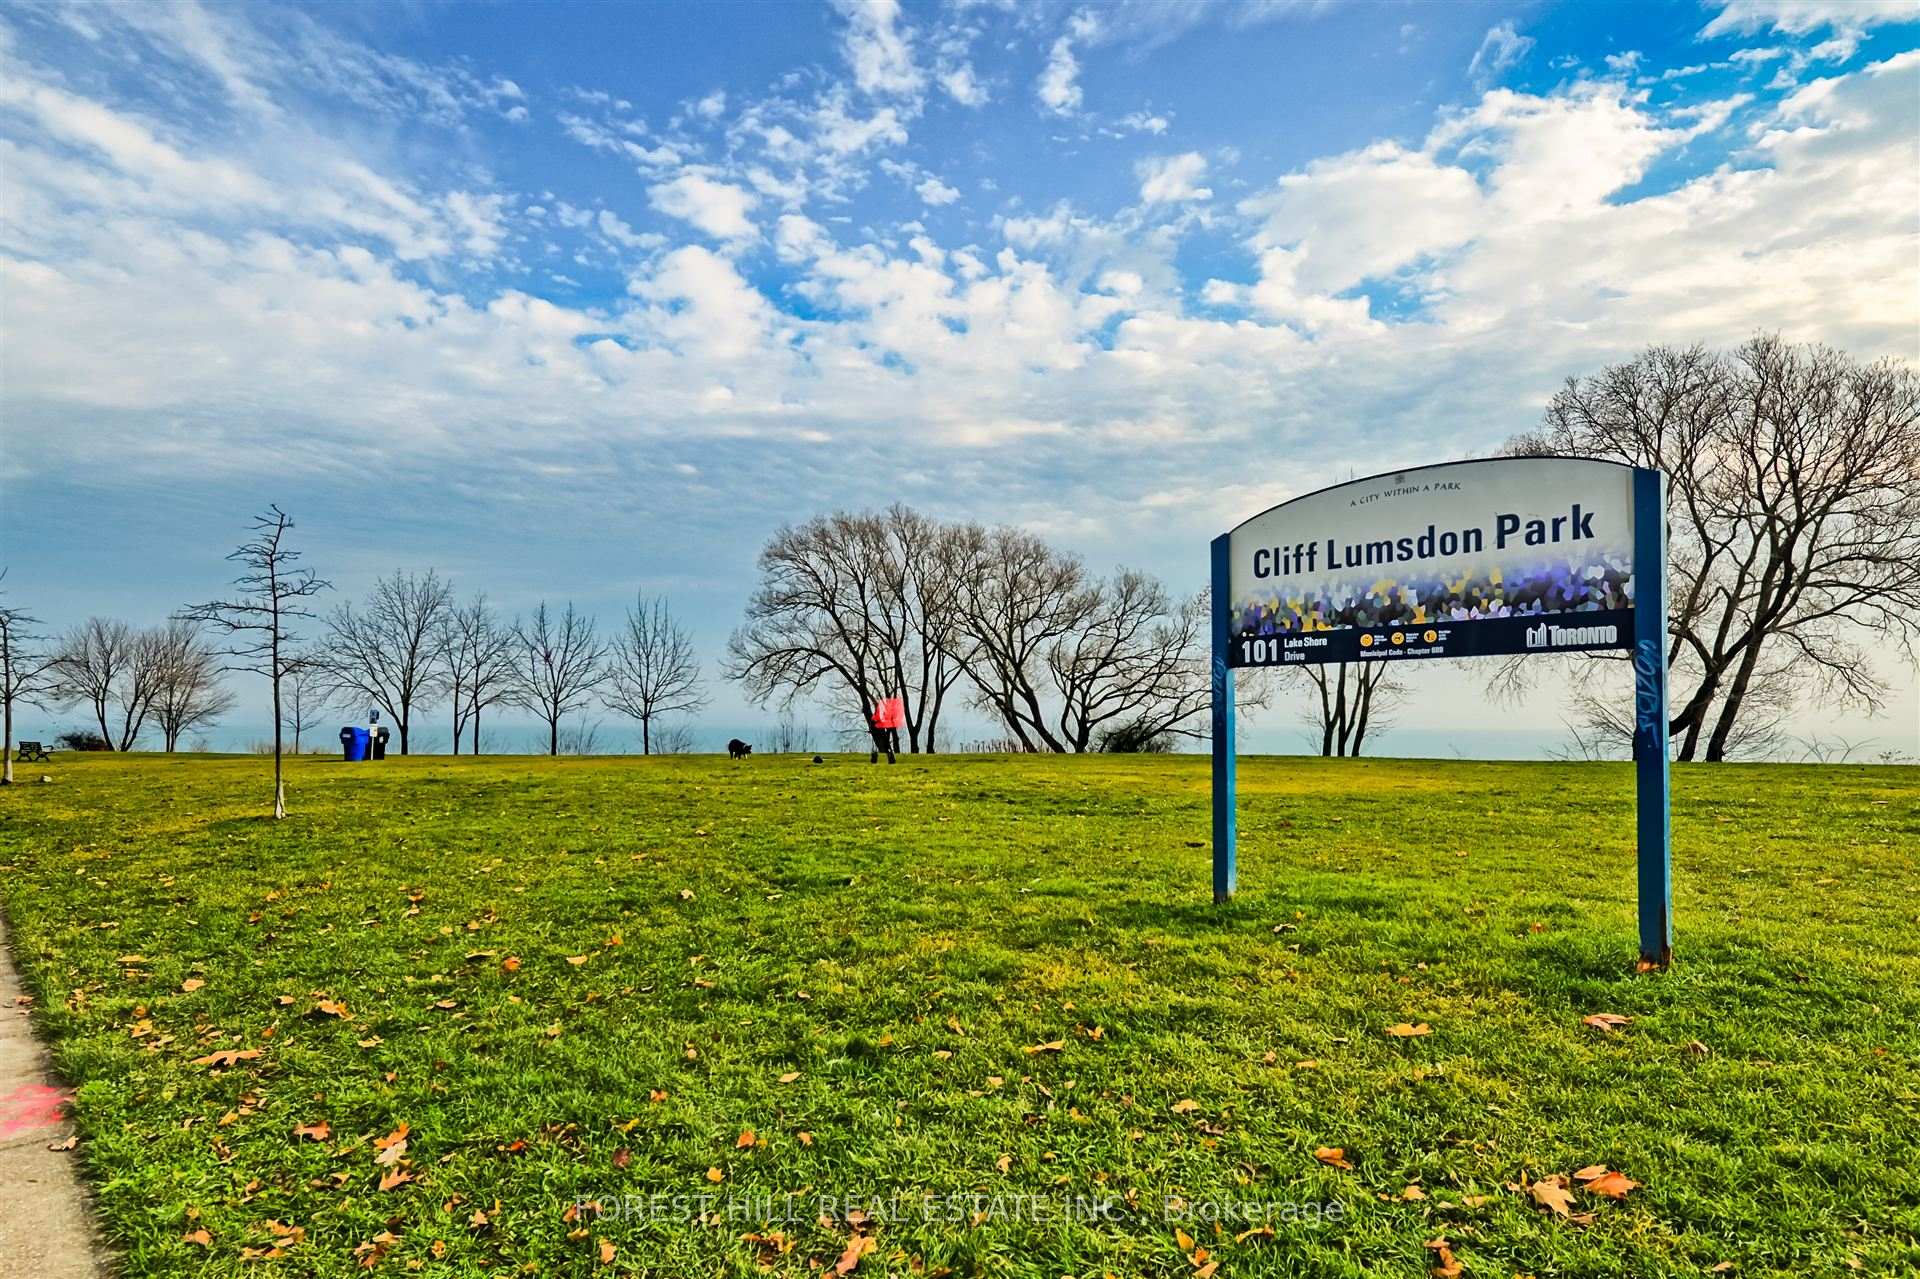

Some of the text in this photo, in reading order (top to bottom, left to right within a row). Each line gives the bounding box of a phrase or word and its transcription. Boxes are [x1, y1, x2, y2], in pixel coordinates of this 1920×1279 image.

[1359, 493, 1380, 505] CITY
[1383, 485, 1420, 497] WITHIN
[1434, 482, 1462, 491] PARK
[1253, 503, 1595, 579] Cliff Lumsdon Park
[1284, 636, 1328, 648] Lake Shore
[1548, 624, 1618, 647] TORONTO
[1241, 638, 1278, 664] 101
[1284, 651, 1306, 662] Drive
